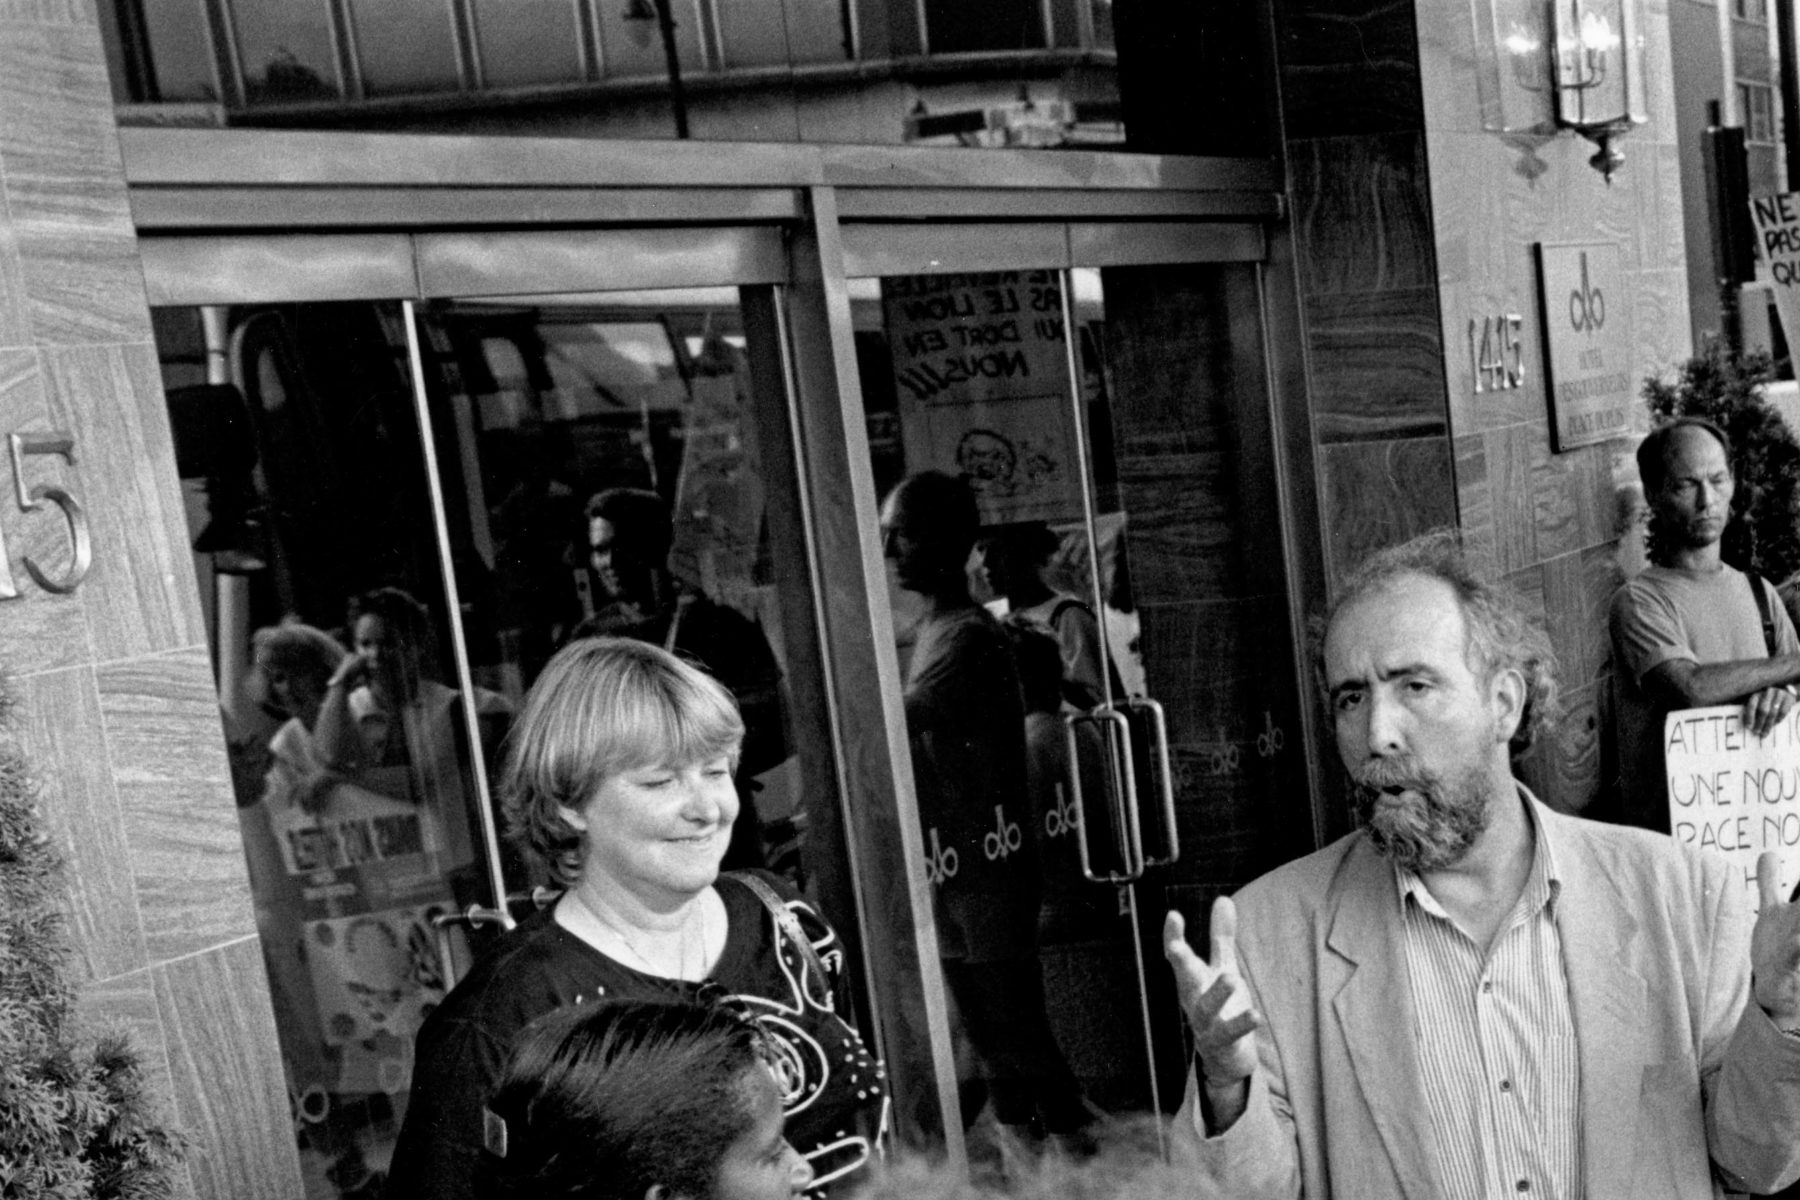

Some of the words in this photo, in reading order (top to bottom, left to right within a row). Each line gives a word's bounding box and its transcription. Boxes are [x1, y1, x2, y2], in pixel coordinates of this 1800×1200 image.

[1754, 191, 1798, 228] NE
[1468, 314, 1526, 395] 1415
[1671, 769, 1732, 808] UNE
